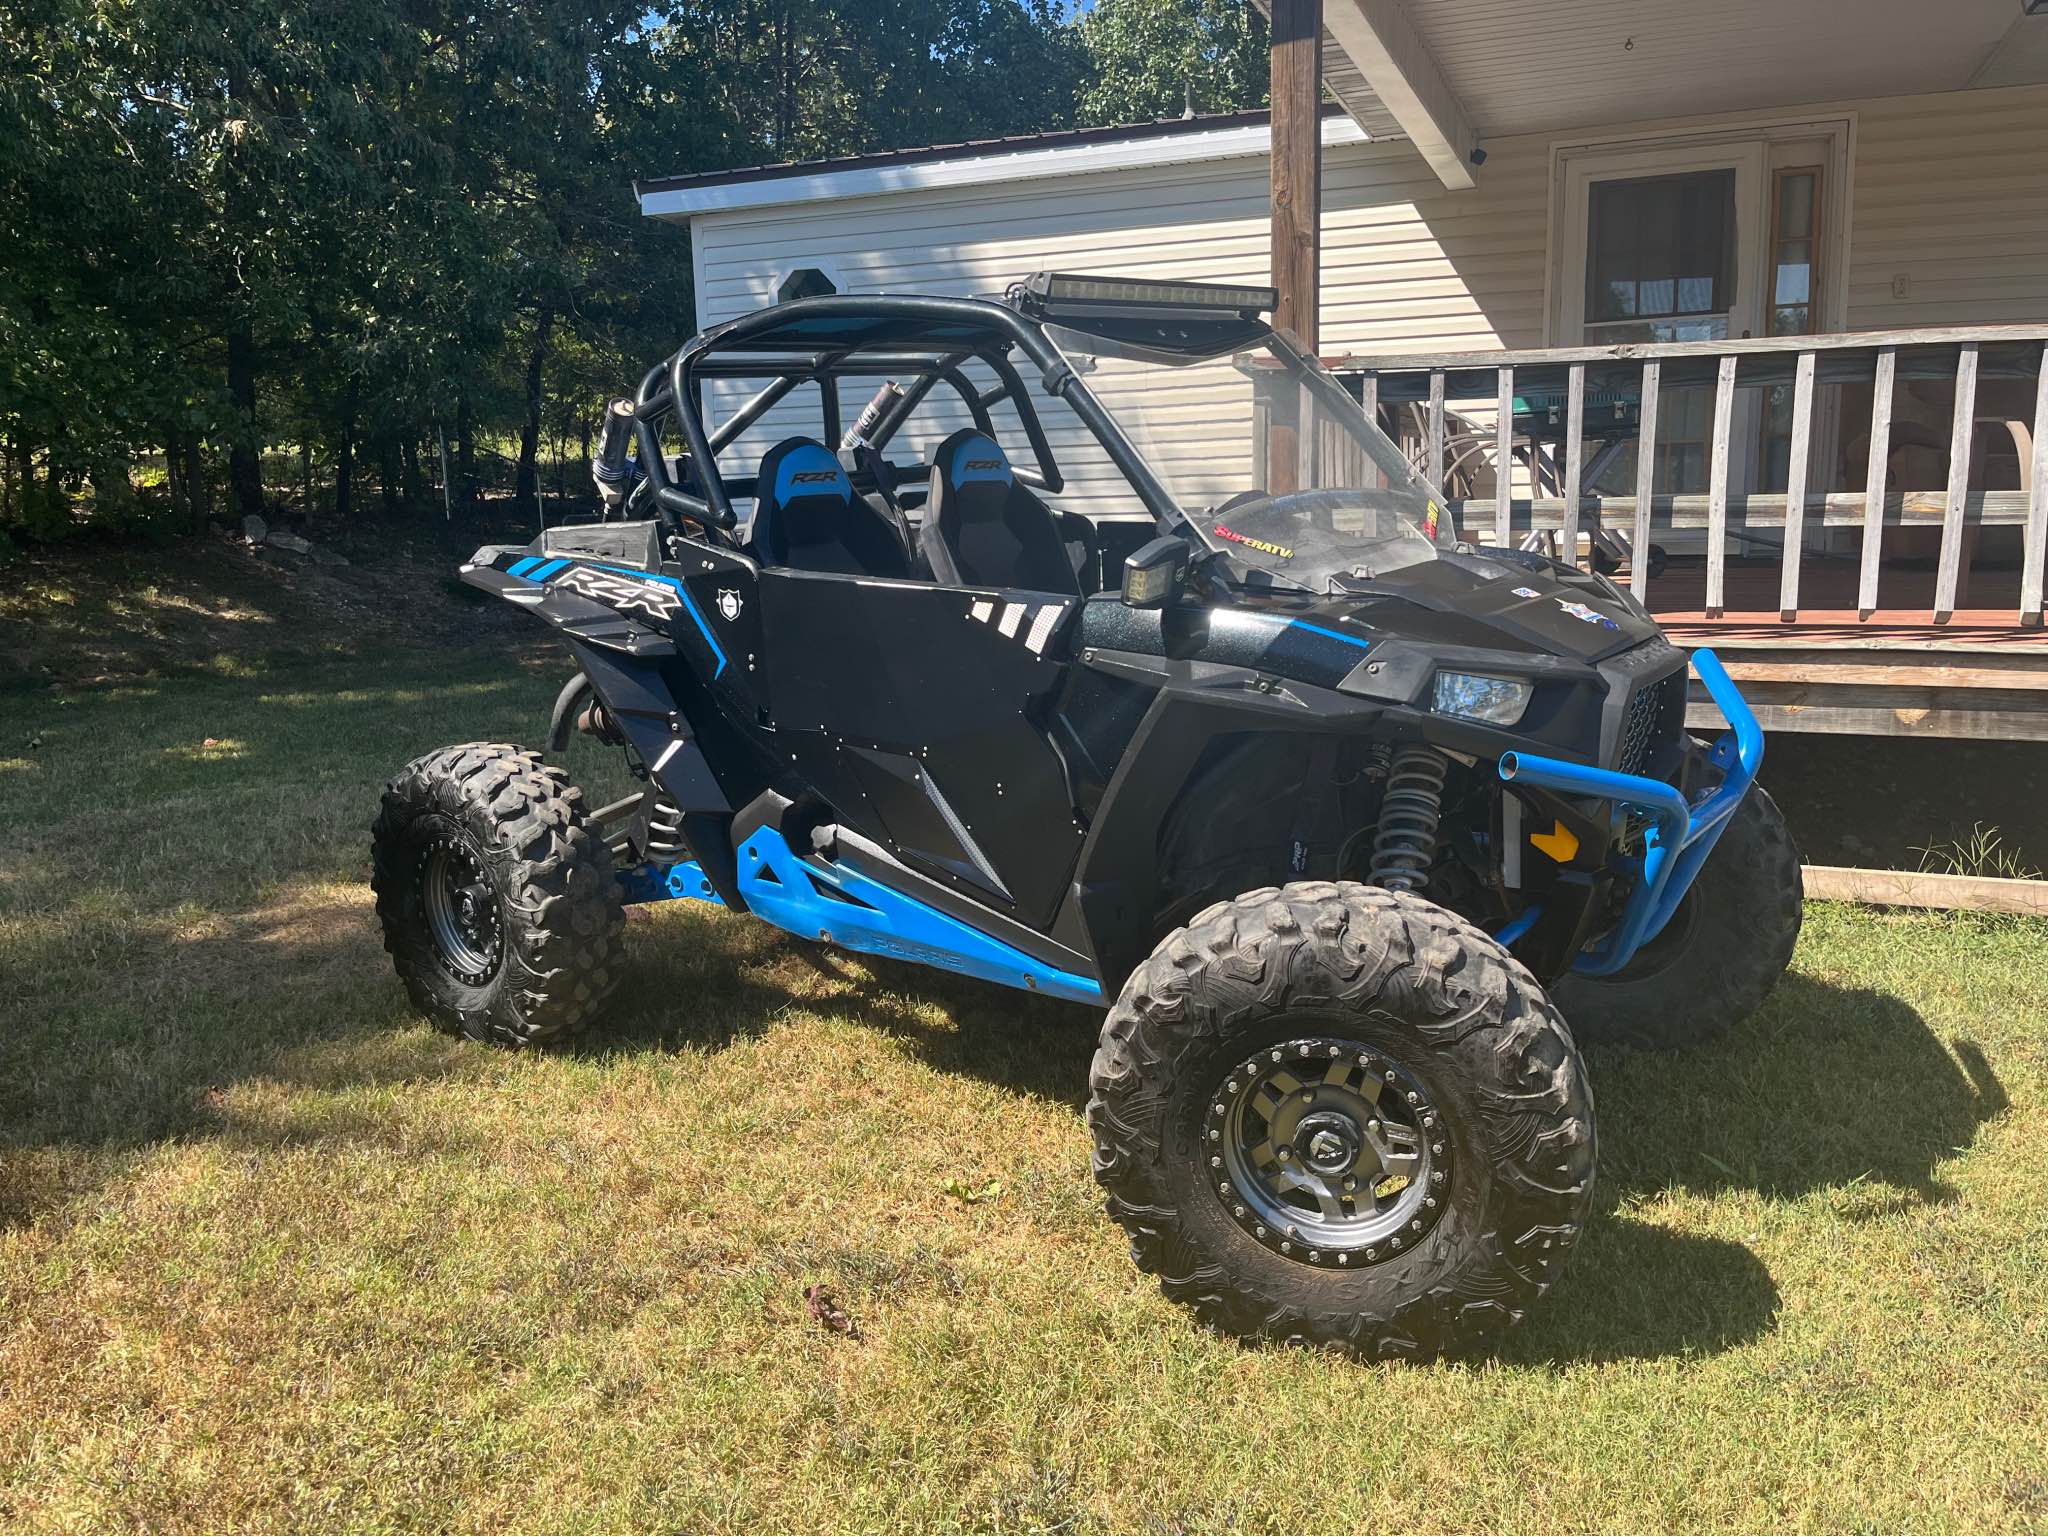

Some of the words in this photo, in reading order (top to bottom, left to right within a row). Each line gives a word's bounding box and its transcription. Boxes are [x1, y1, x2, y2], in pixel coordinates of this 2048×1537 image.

[790, 470, 838, 485] RZR
[963, 459, 1001, 472] RZR
[1213, 524, 1293, 559] SUPERATV
[555, 566, 682, 620] RZR
